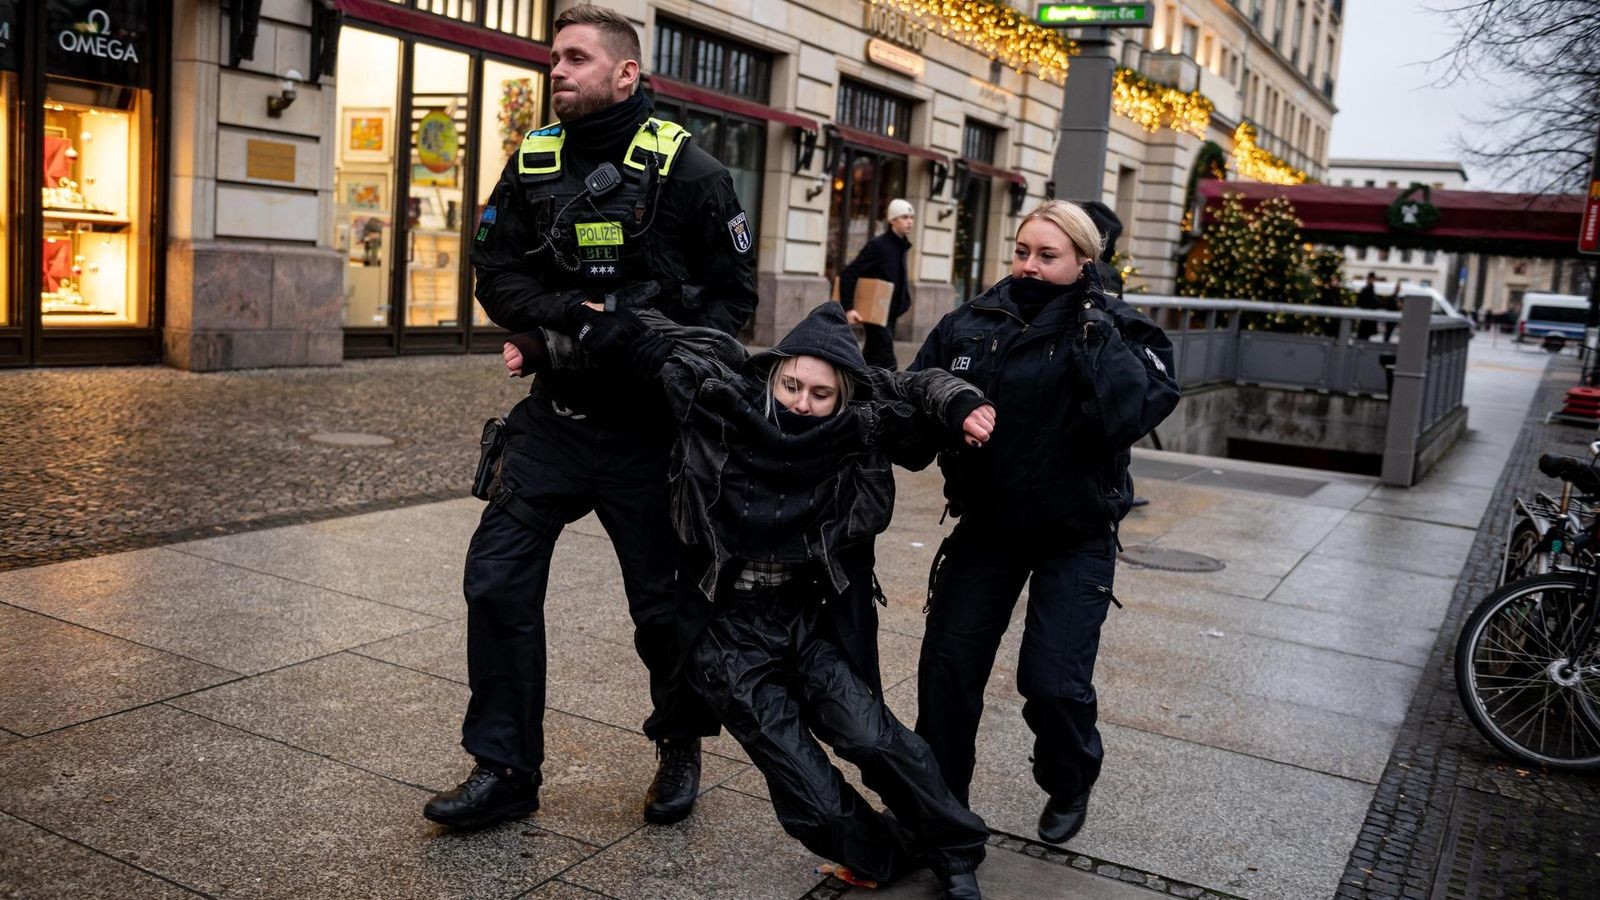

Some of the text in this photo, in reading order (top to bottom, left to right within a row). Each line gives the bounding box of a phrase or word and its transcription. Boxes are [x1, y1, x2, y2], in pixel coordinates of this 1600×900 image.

[59, 30, 139, 63] OMEGA
[578, 226, 621, 243] POLIZEI
[586, 246, 613, 259] BFE
